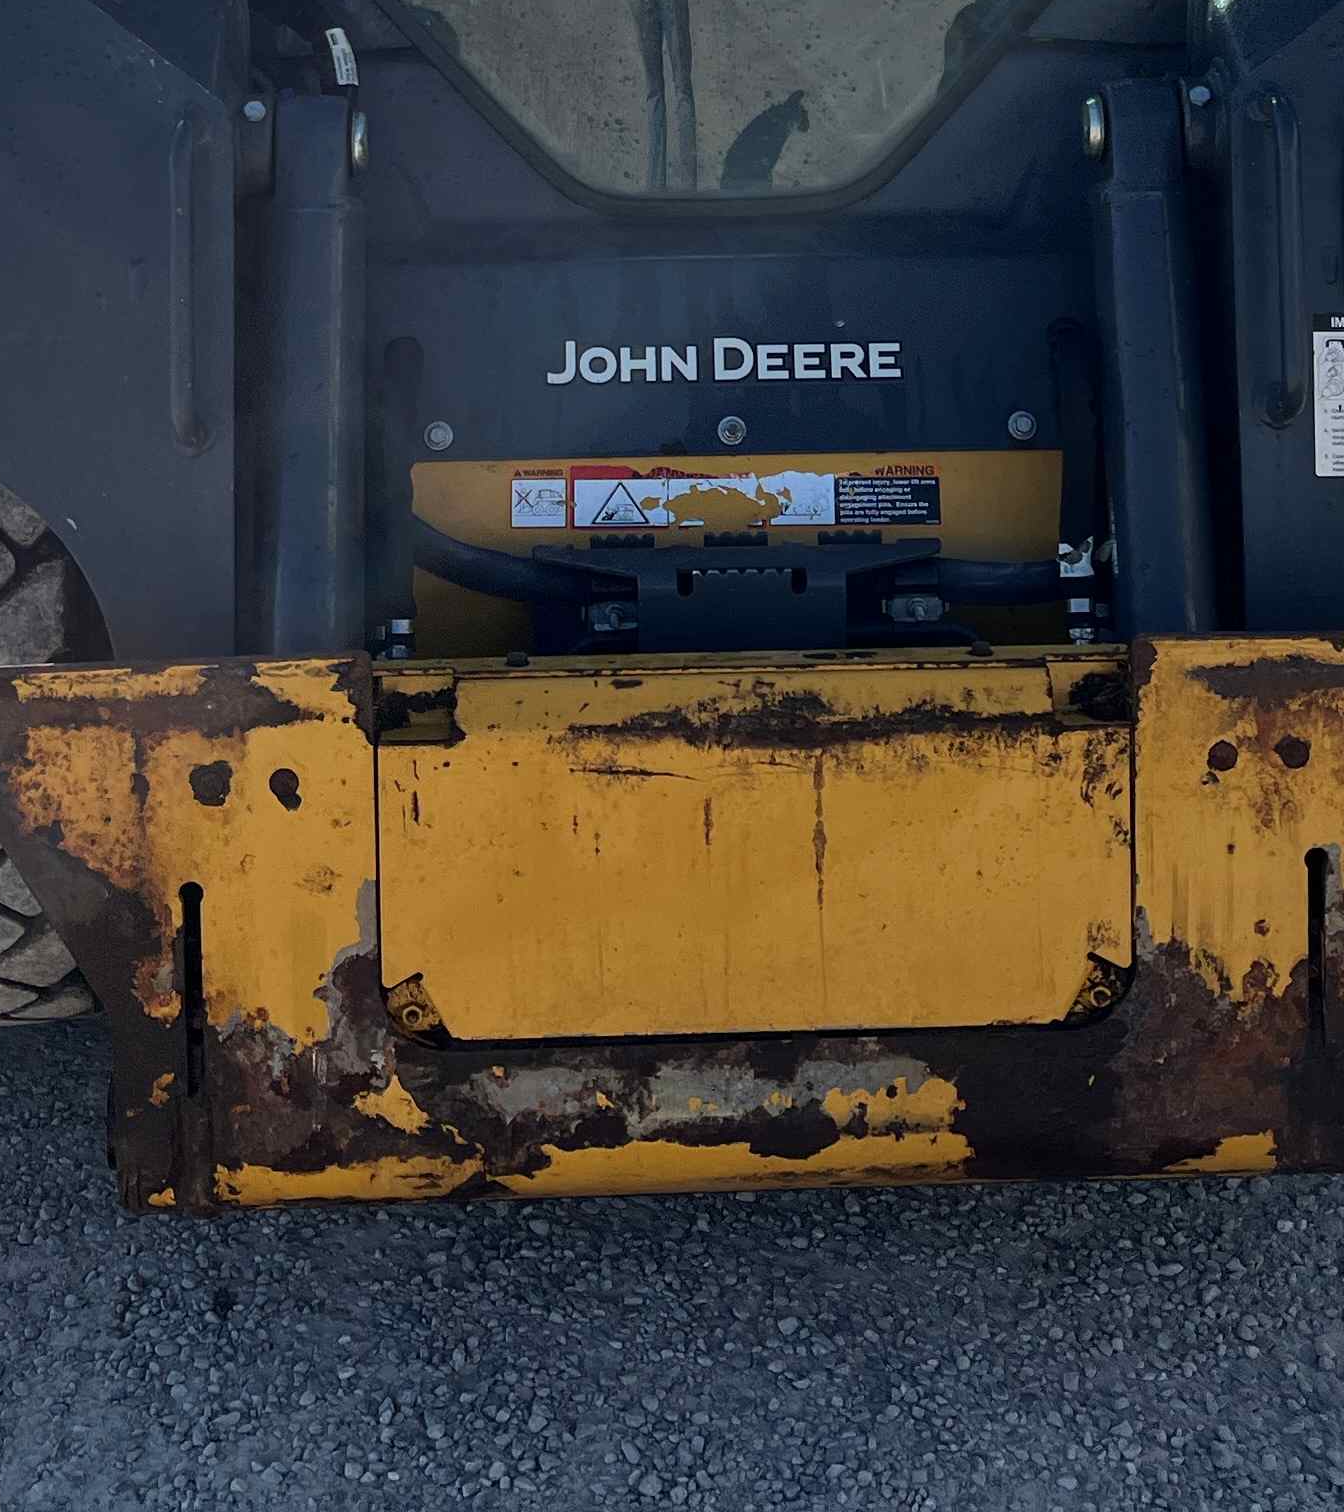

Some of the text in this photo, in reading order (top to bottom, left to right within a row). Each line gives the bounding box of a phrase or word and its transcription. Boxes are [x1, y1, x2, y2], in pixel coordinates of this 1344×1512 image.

[547, 337, 902, 385] JOHN DEERE
[874, 465, 934, 476] WARNING
